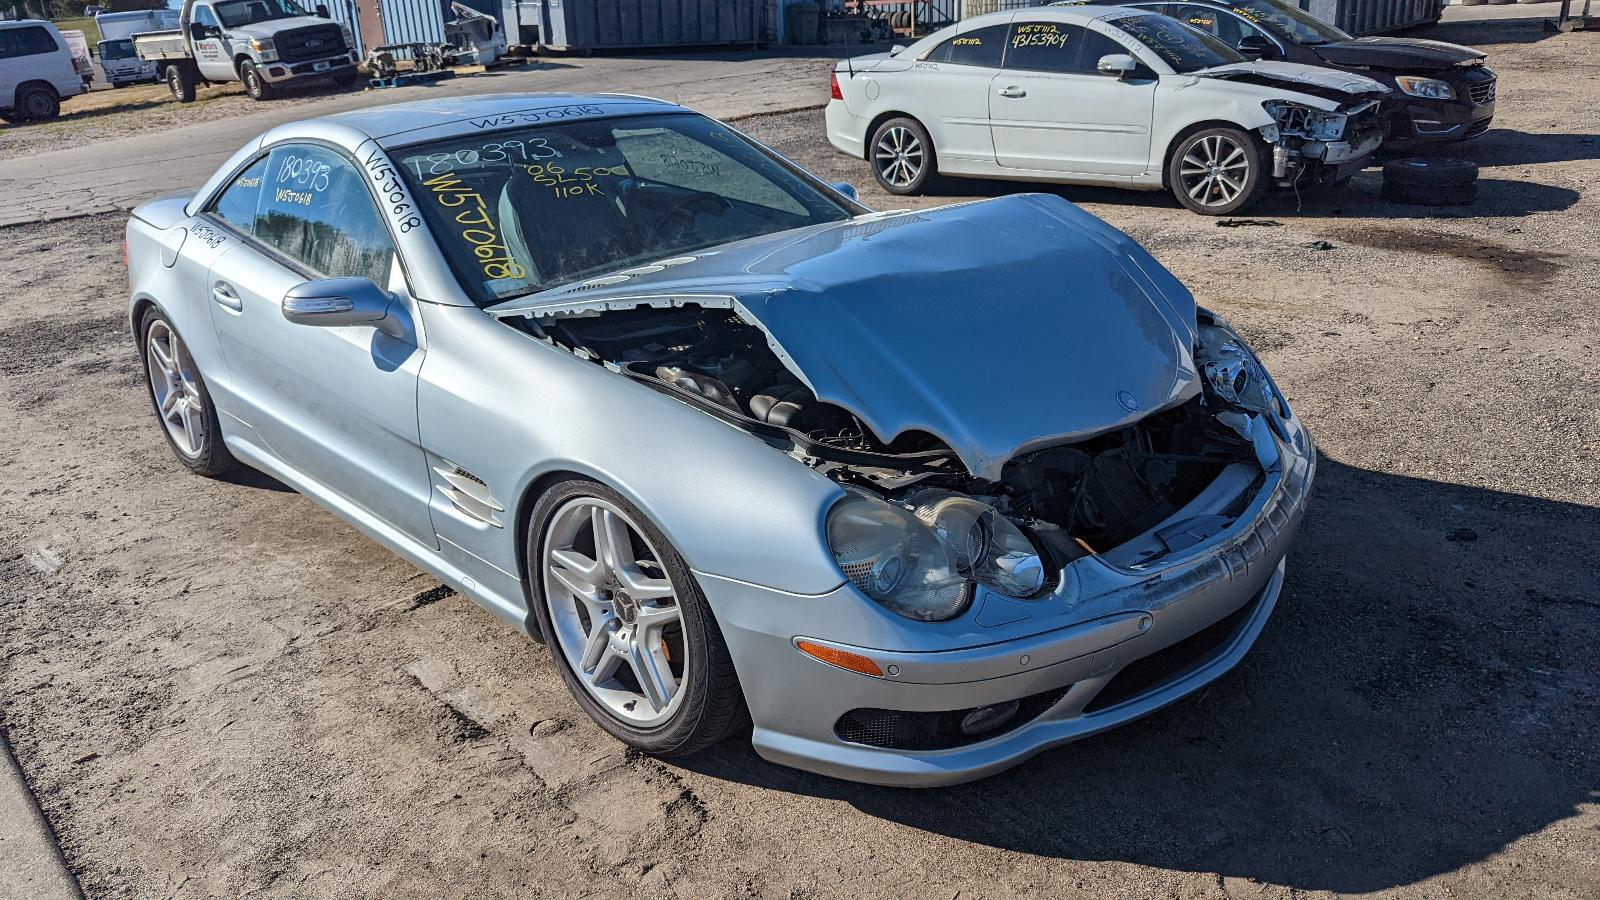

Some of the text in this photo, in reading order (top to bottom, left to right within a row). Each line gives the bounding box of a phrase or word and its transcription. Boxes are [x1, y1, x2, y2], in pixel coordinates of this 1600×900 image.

[1012, 33, 1068, 48] 43153904
[470, 104, 605, 129] W5J0618
[414, 138, 562, 181] 180393
[275, 155, 331, 192] 180393
[275, 187, 313, 206] W5J0618
[365, 150, 421, 234] W5J0618
[555, 183, 605, 198] 110K
[190, 222, 227, 249] W5J0618
[422, 172, 526, 280] W5J0618
